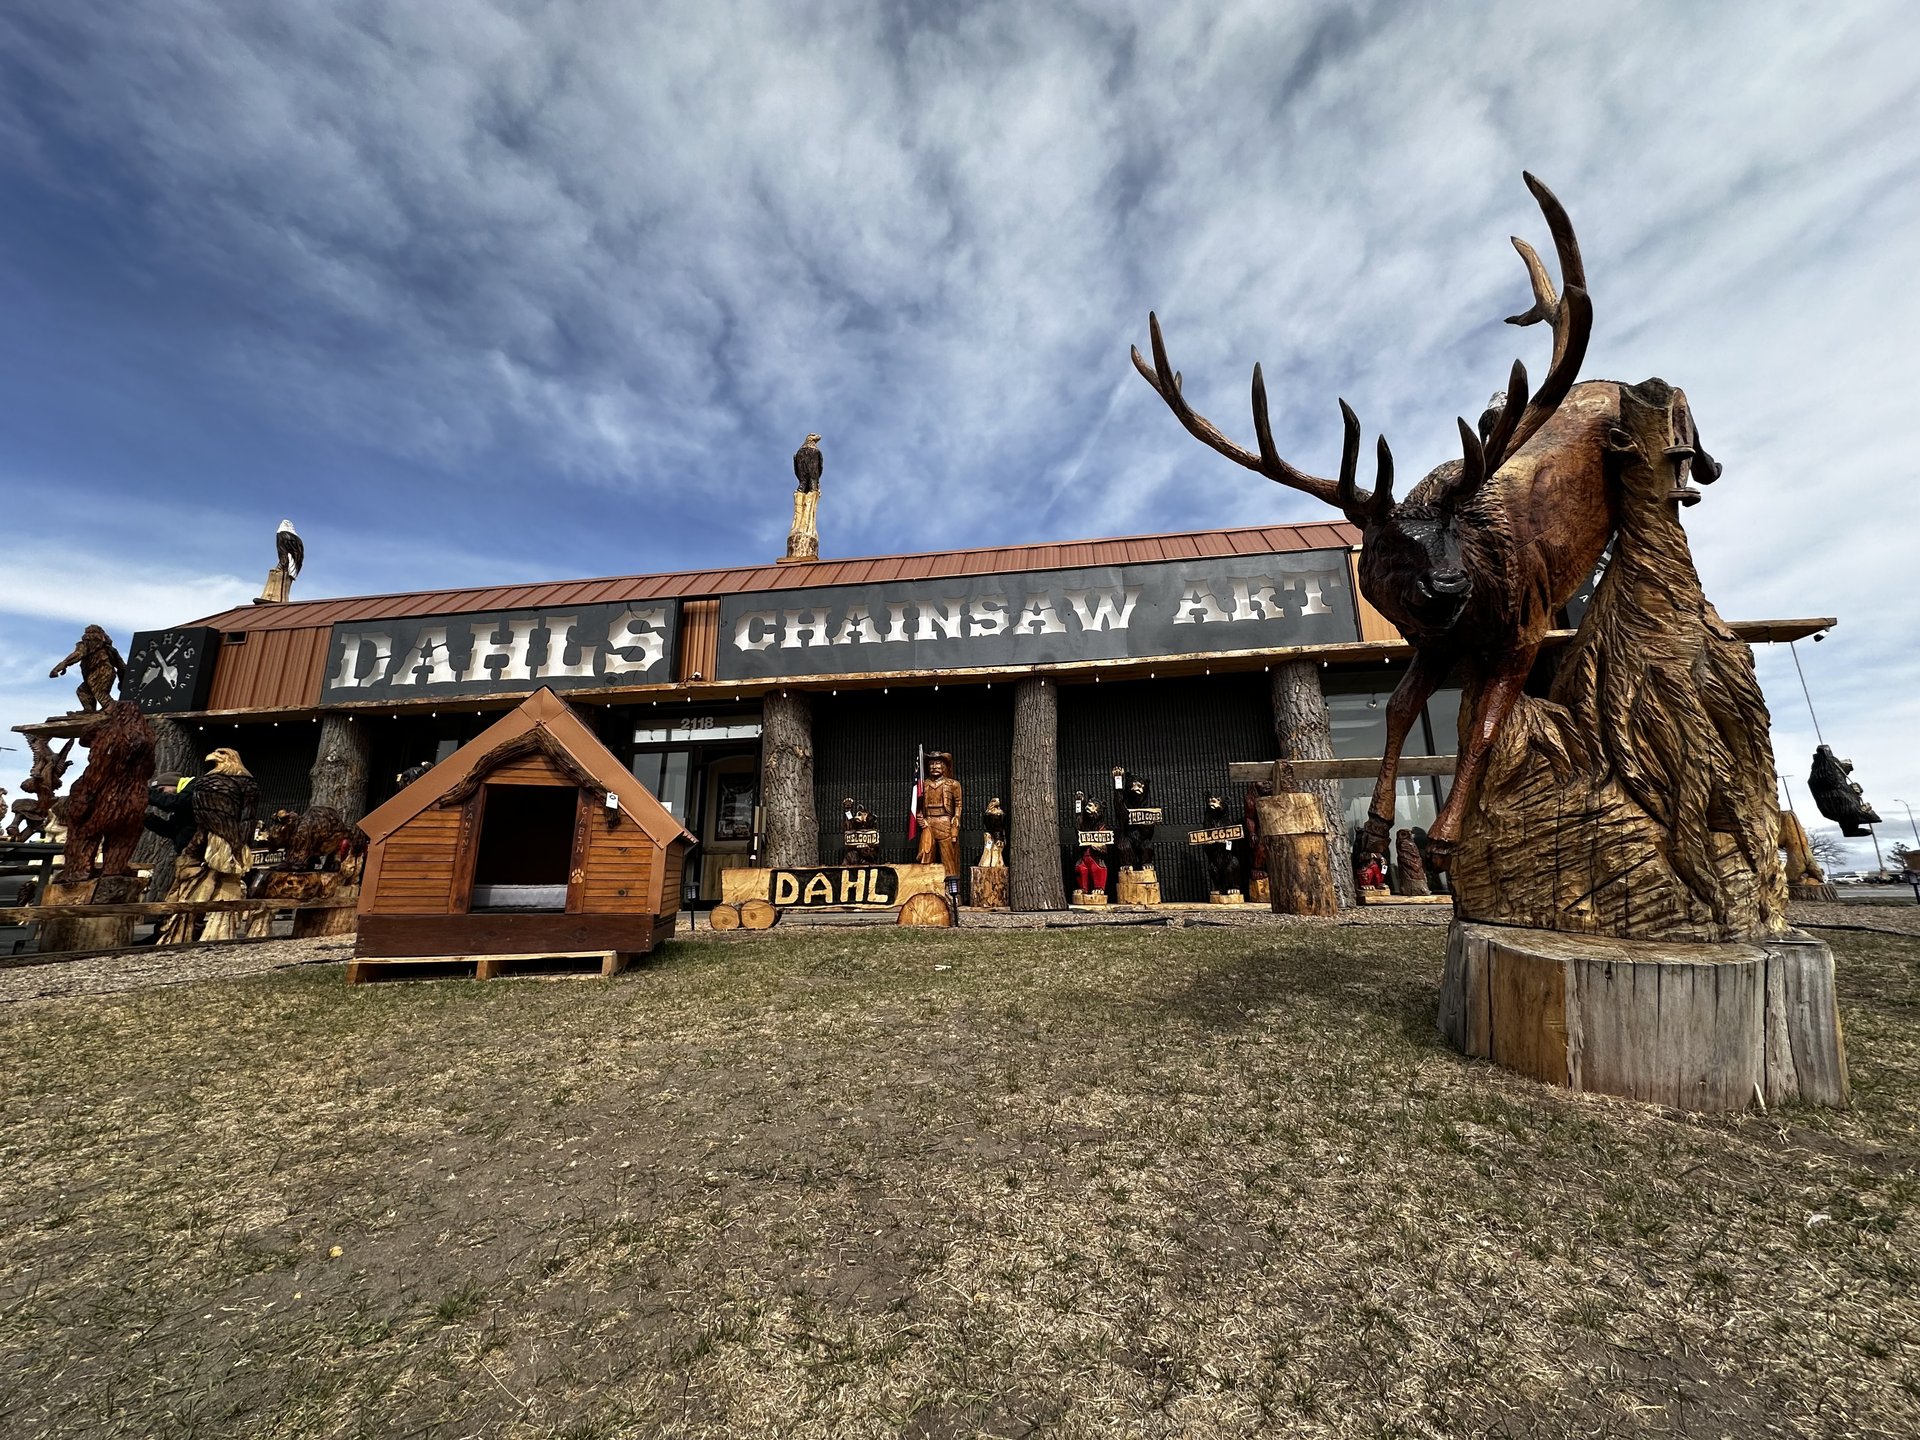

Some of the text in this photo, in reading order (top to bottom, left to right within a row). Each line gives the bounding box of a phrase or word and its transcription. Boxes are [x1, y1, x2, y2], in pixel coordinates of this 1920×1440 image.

[733, 568, 1341, 652] CHAINSAW ART
[330, 607, 667, 690] DAHLS
[680, 716, 714, 731] 2118
[460, 802, 476, 856] CANINE
[575, 806, 590, 854] CABIN
[846, 833, 878, 844] WELCOME
[1081, 832, 1111, 842] WELCOME
[1189, 827, 1241, 843] WELCOME
[775, 868, 889, 905] DAHL
